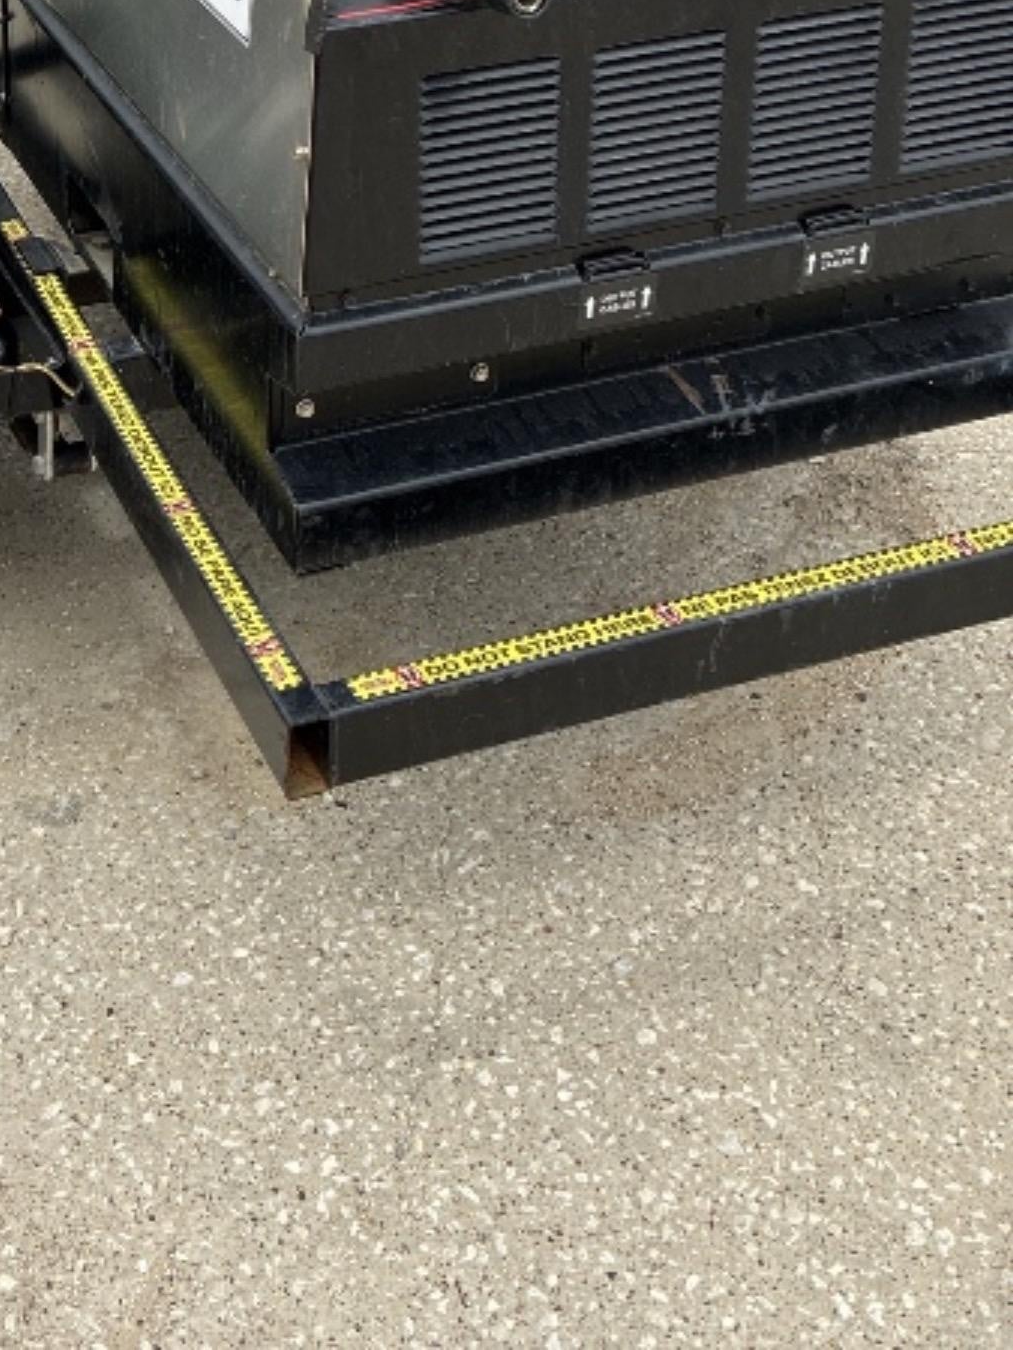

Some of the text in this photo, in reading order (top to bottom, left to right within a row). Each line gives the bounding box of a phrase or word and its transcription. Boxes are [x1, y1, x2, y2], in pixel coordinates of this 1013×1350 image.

[426, 661, 460, 676] DO
[463, 648, 510, 667] NOT
[514, 629, 591, 655] STAND
